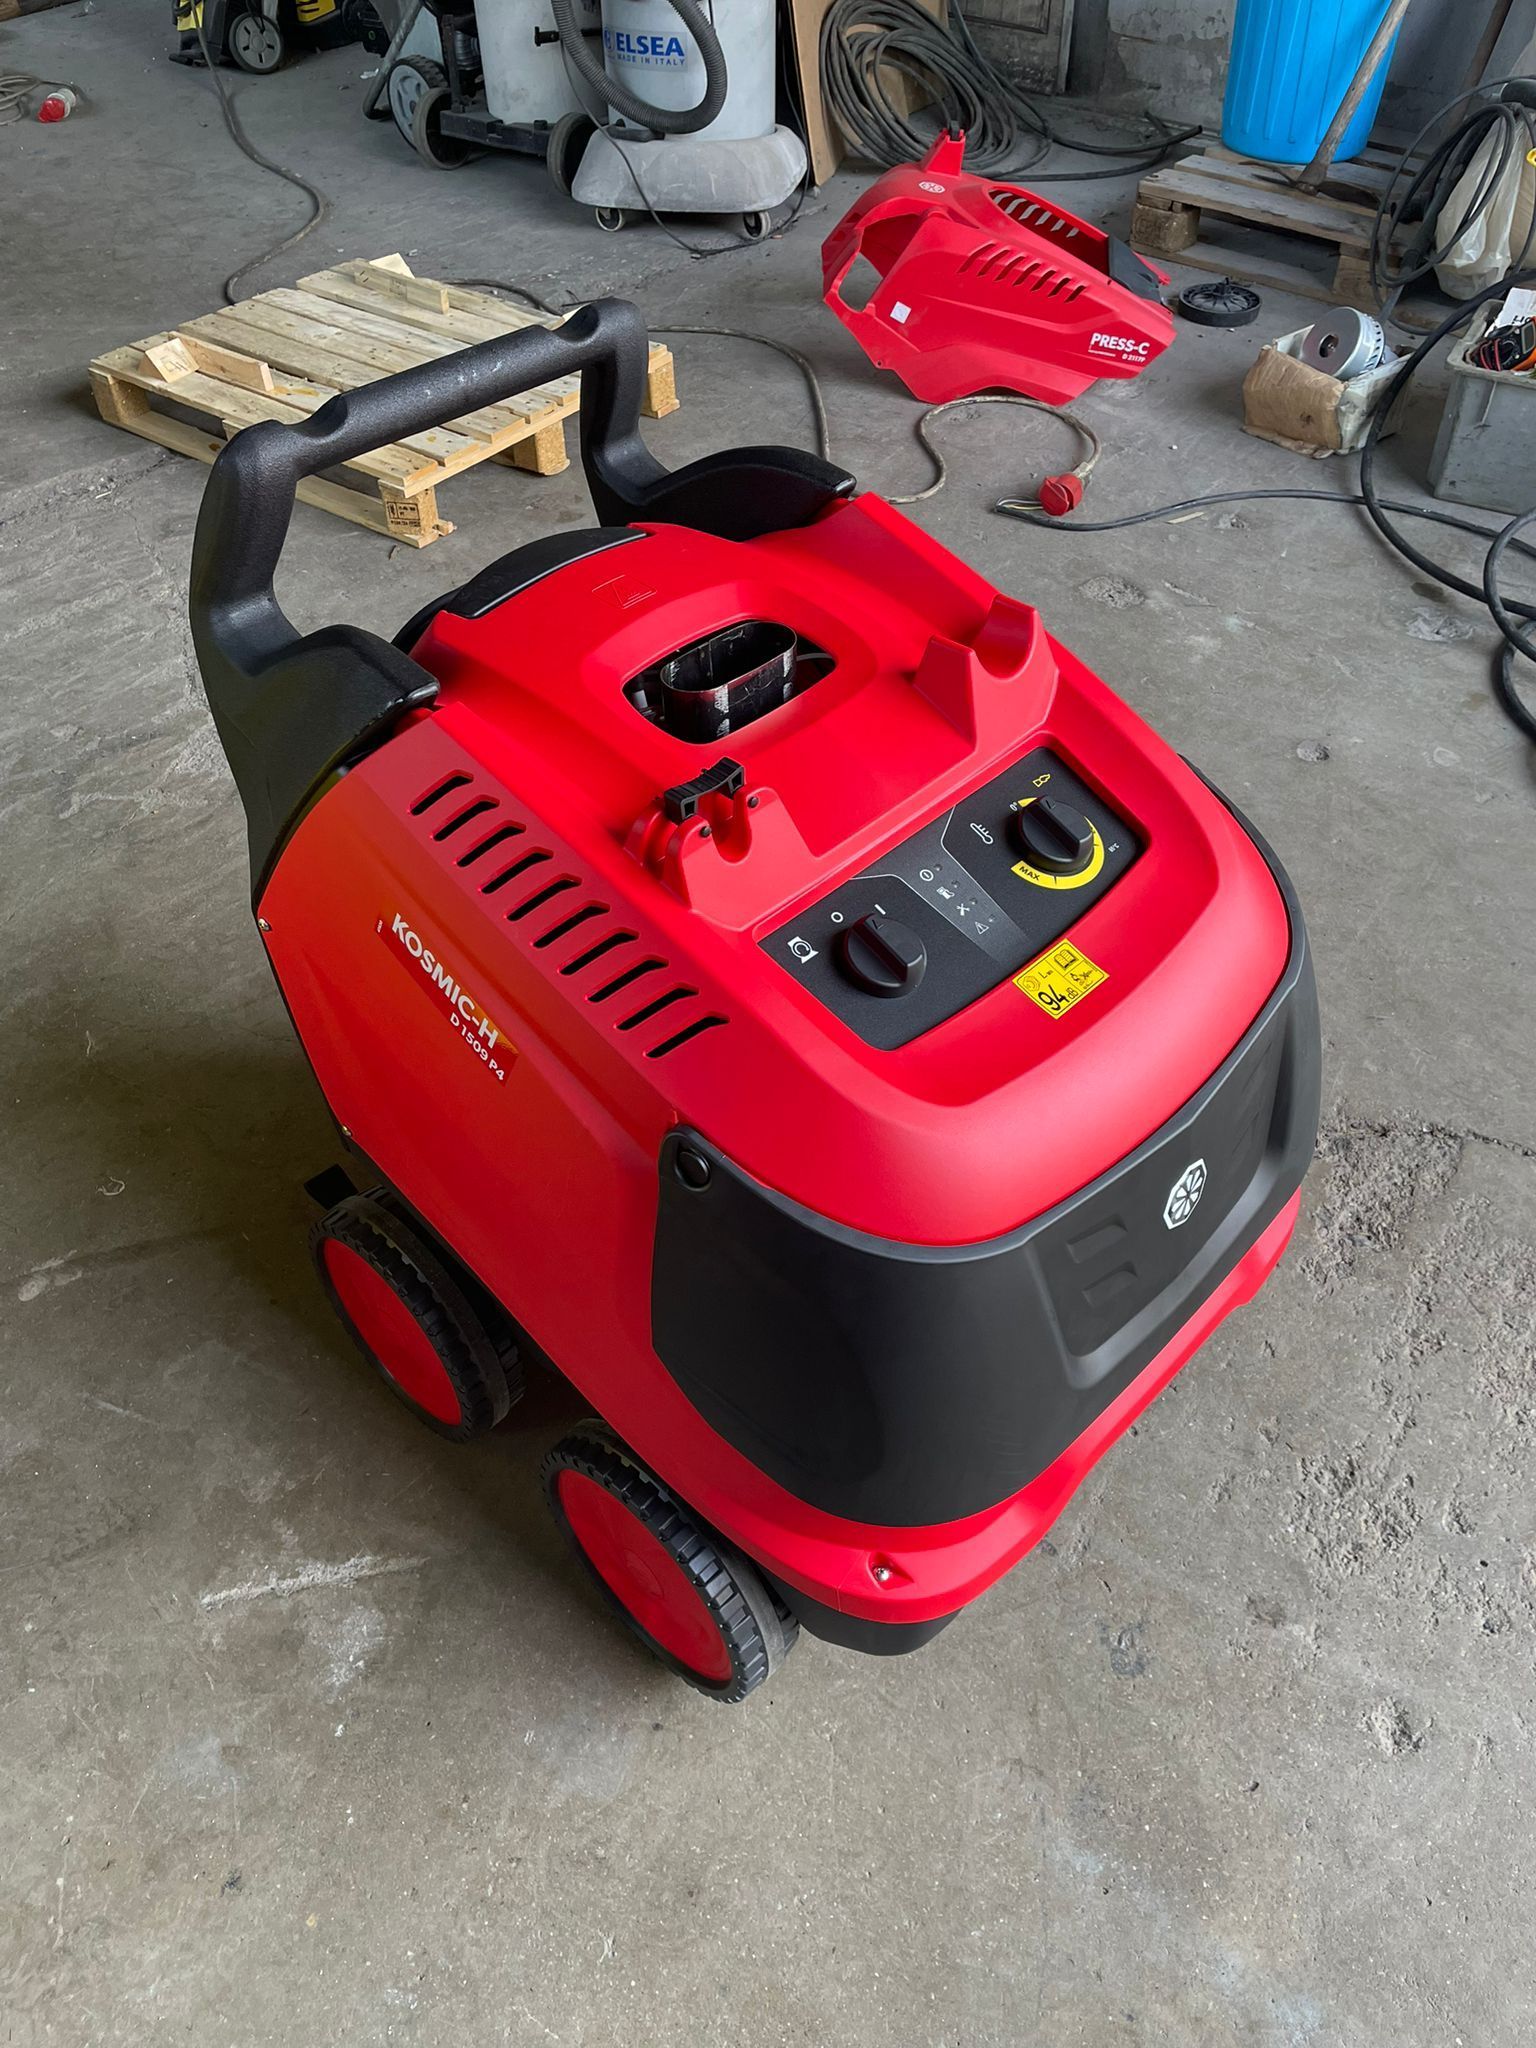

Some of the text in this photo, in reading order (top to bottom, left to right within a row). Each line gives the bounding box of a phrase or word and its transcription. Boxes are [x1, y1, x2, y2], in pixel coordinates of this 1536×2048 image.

[616, 32, 685, 57] ELSEA
[617, 54, 685, 66] MADE IN ITALY
[1090, 332, 1150, 355] PRESS-C
[1019, 866, 1041, 881] MAX
[391, 912, 499, 1049] KOSMIC-H
[1037, 984, 1070, 1011] 94
[1066, 987, 1079, 999] dB
[449, 1012, 505, 1081] D 1509 P4
